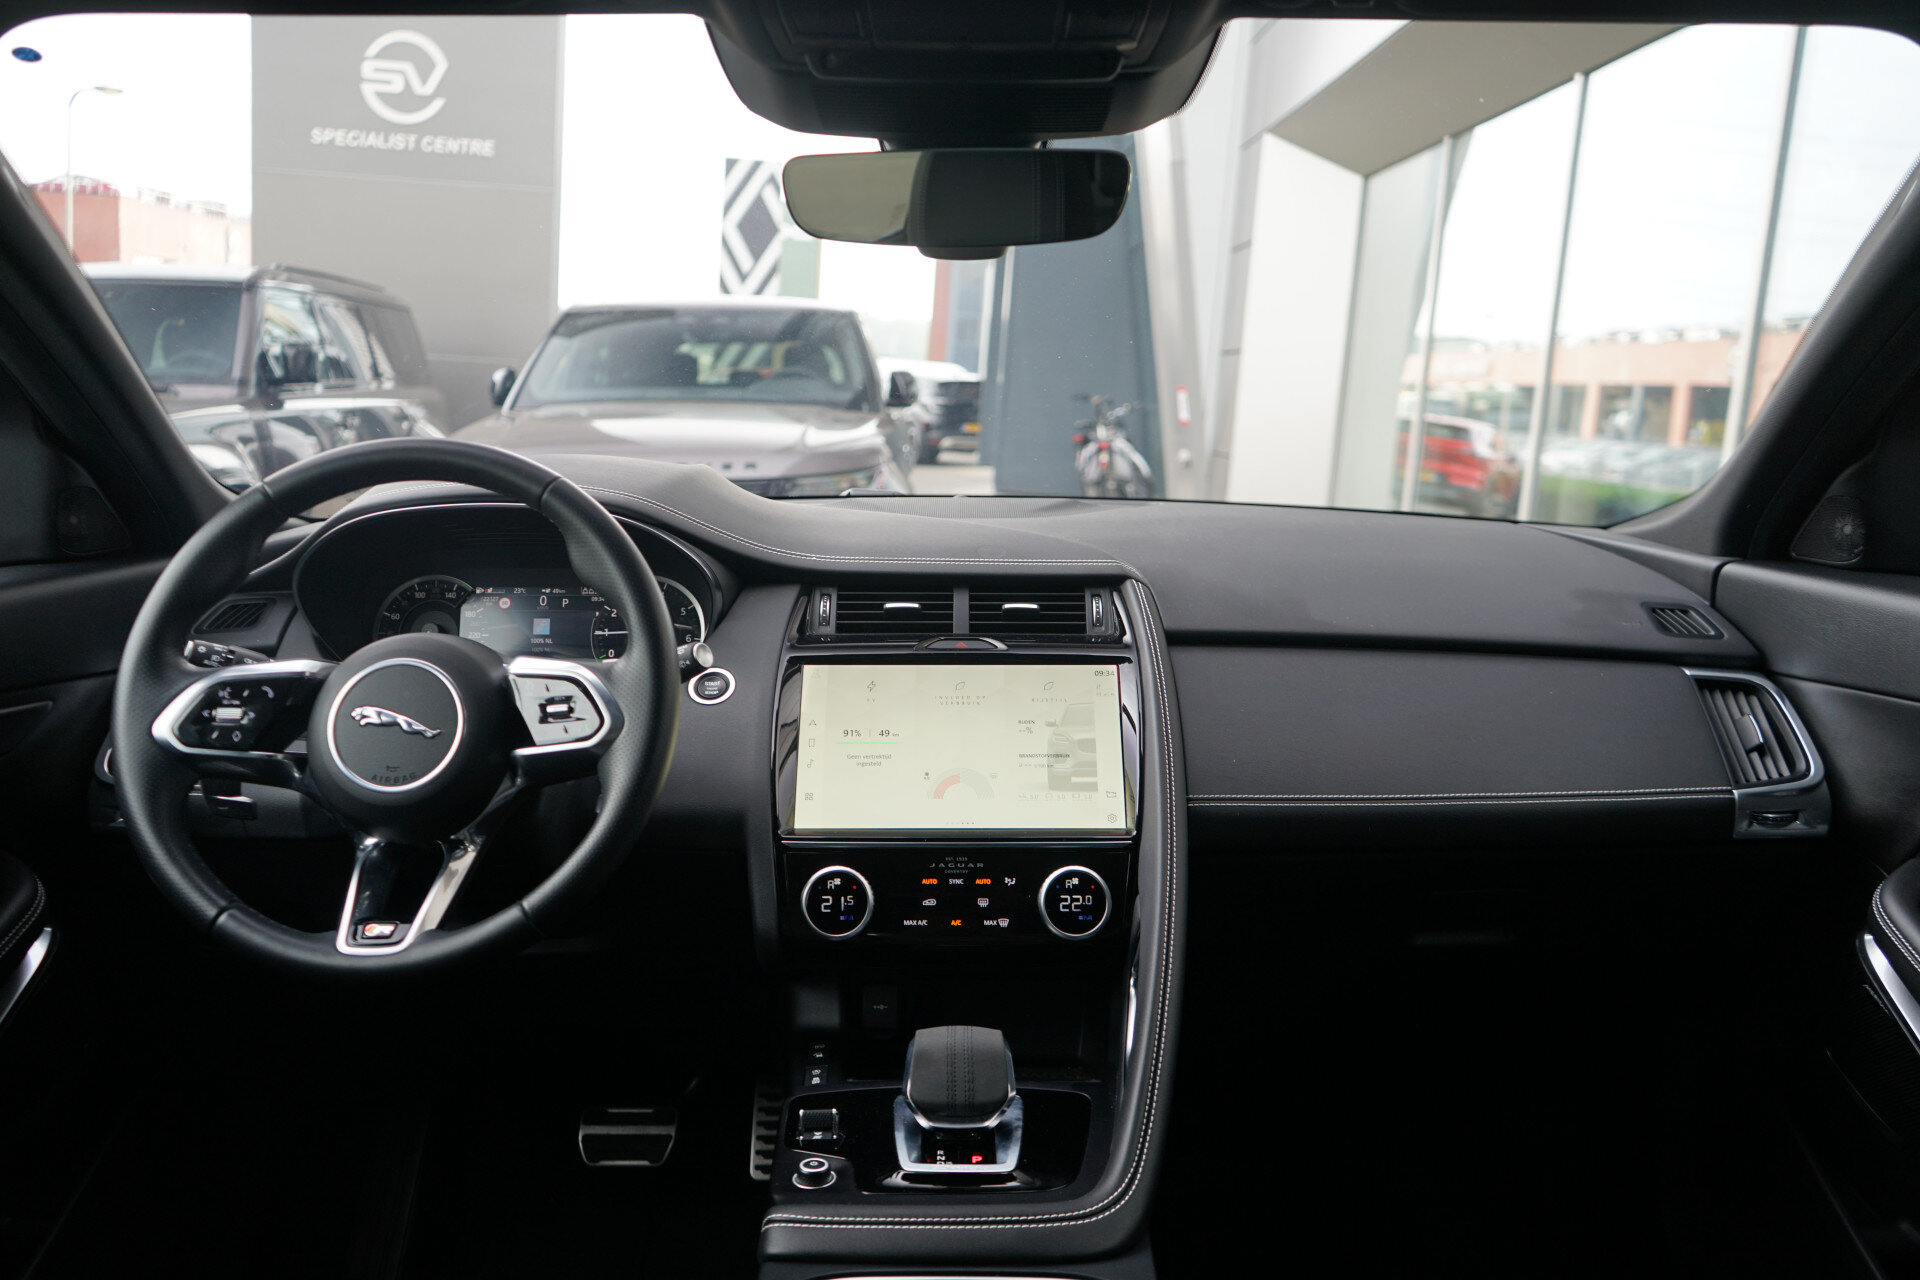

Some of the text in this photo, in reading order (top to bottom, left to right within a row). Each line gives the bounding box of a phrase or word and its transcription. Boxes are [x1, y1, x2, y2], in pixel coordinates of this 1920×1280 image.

[310, 126, 496, 157] SPECIALIST CENTRE
[539, 595, 548, 606] 0
[562, 598, 569, 608] P
[611, 608, 617, 618] 2
[680, 607, 686, 616] 5
[685, 633, 692, 643] 6
[608, 649, 615, 658] 0
[843, 729, 862, 738] 91%
[878, 729, 890, 738] 49
[1059, 894, 1093, 912] 22.0
[971, 1155, 983, 1164] P
